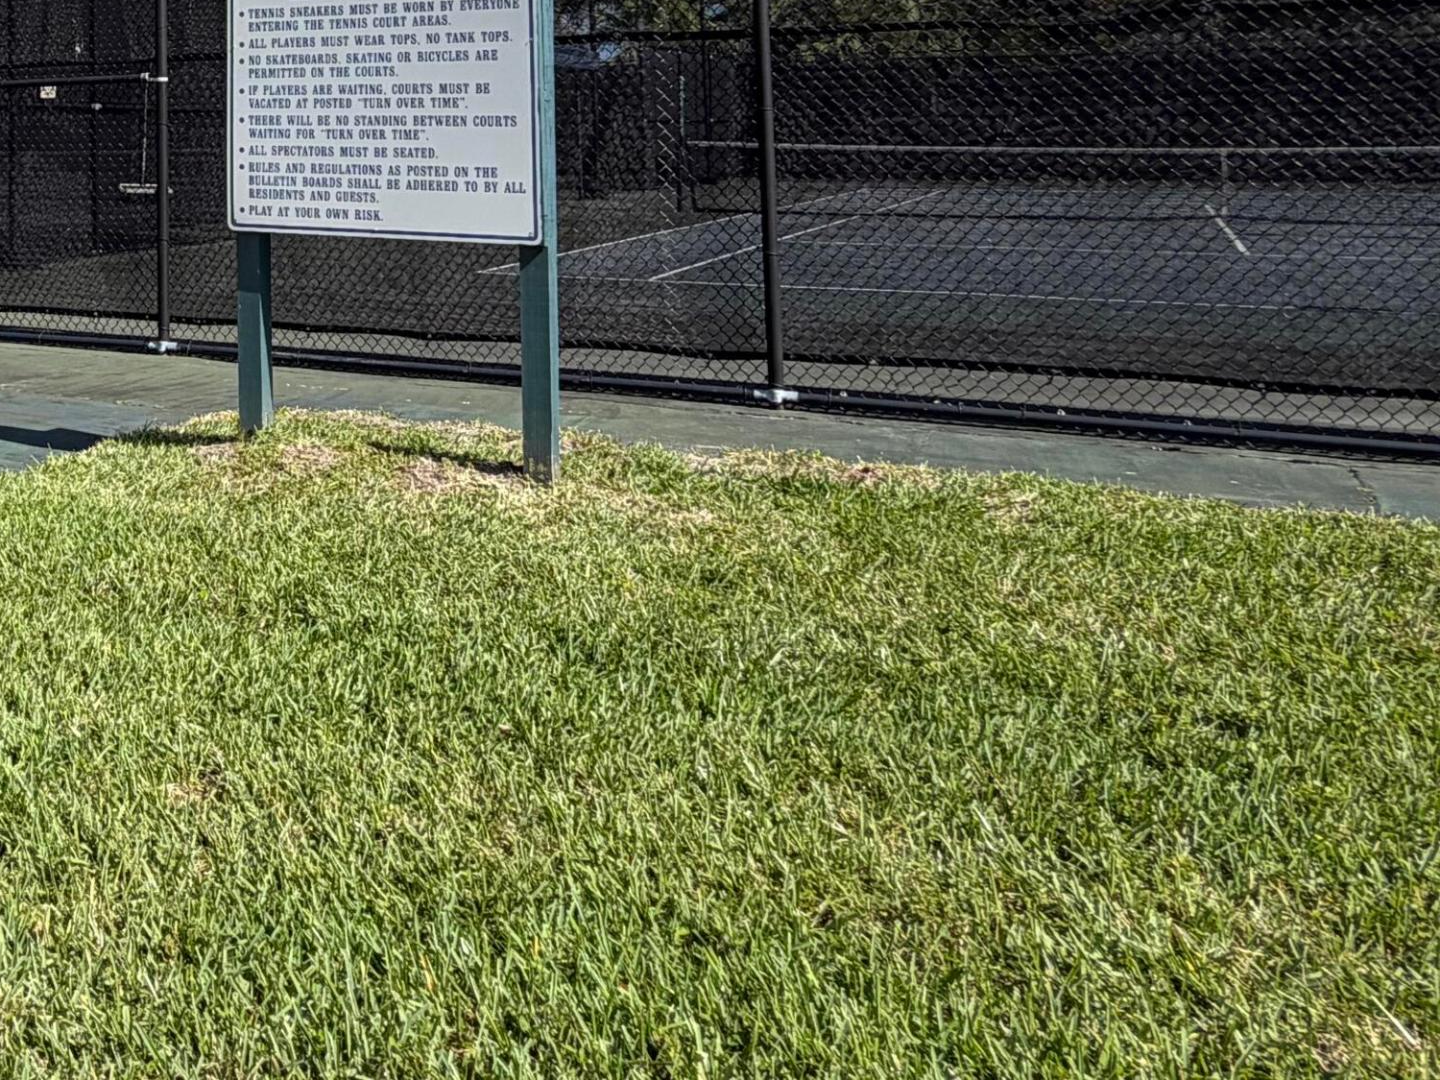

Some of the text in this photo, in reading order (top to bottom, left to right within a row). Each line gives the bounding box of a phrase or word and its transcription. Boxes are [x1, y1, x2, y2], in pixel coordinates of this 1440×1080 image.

[248, 8, 285, 19] TENNIS
[290, 5, 344, 18] SNEAKERS
[349, 4, 379, 15] MUST
[384, 3, 397, 14] BE
[403, 2, 435, 13] WORN
[440, 0, 454, 11] BY
[248, 15, 452, 32] ENTERING THE TENNIS COURT AREAS.
[248, 38, 267, 49] ALL
[272, 37, 316, 49] PLAYERS
[321, 36, 349, 47] MUST
[354, 35, 385, 46] WEAR
[426, 33, 440, 44] NO
[446, 32, 475, 43] TANK
[481, 31, 513, 42] TOPS.
[248, 55, 261, 66] NO
[346, 52, 392, 64] SKATING
[397, 52, 411, 63] OR
[418, 50, 469, 62] BICYCLES
[475, 50, 499, 61] ARE
[248, 66, 399, 79] PERMITTED ON THE COURTS.
[248, 85, 258, 95] IF
[263, 85, 307, 96] PLAYERS
[312, 85, 333, 95] ARE
[392, 84, 433, 95] COURTS
[439, 83, 470, 94] MUST
[476, 83, 491, 94] BE
[249, 98, 291, 109] VACATED
[296, 98, 309, 108] AT
[314, 98, 352, 109] POSTED
[396, 98, 425, 109] OVER
[248, 115, 517, 127] THERE WILL BE NO STANDING BETWEEN COURTS
[249, 128, 291, 139] WAITING
[296, 129, 316, 139] FOR
[359, 129, 387, 140] OVER
[249, 146, 439, 159] ALL SPECTATORS MUST BE SEATED.
[248, 162, 498, 178] RULES AND REGULATIONS AS POSTED ON THE
[248, 176, 527, 194] BULLETIN BOARDS SHALL BE ADHERED TO BY ALL
[248, 189, 380, 204] RESIDENTS AND GUESTS.
[249, 206, 384, 221] PLAY AT YOUR OWN RISK.
